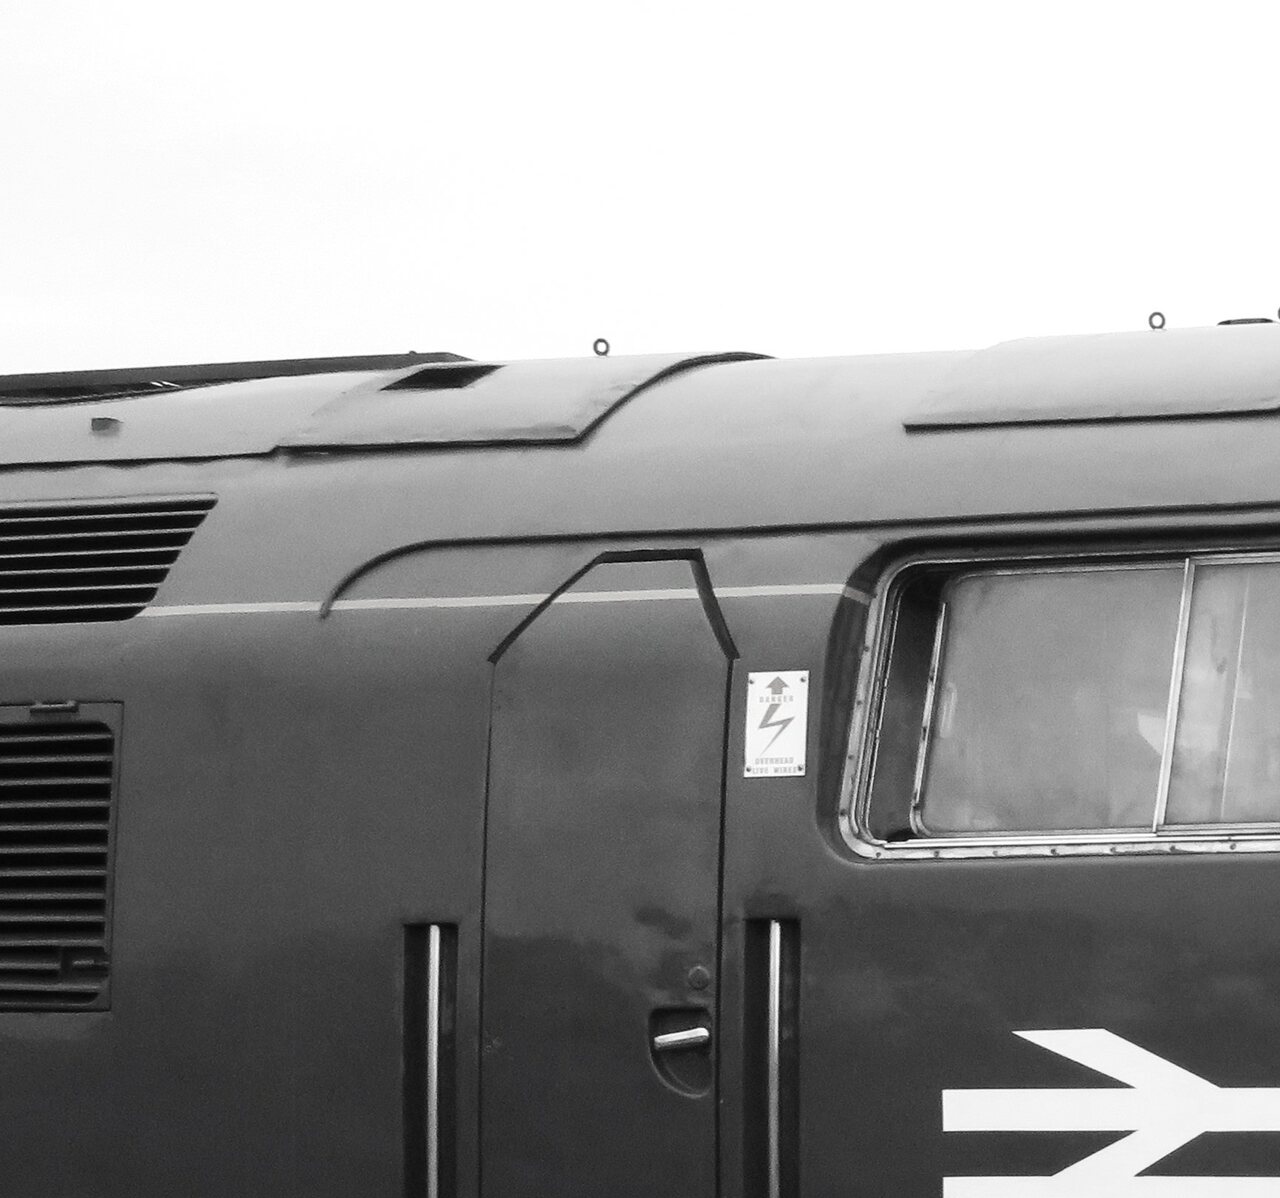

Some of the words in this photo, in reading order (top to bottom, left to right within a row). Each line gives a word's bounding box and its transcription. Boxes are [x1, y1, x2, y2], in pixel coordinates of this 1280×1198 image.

[759, 695, 794, 703] DANGER
[755, 757, 794, 765] OVERHEAD
[774, 766, 797, 774] WIRES
